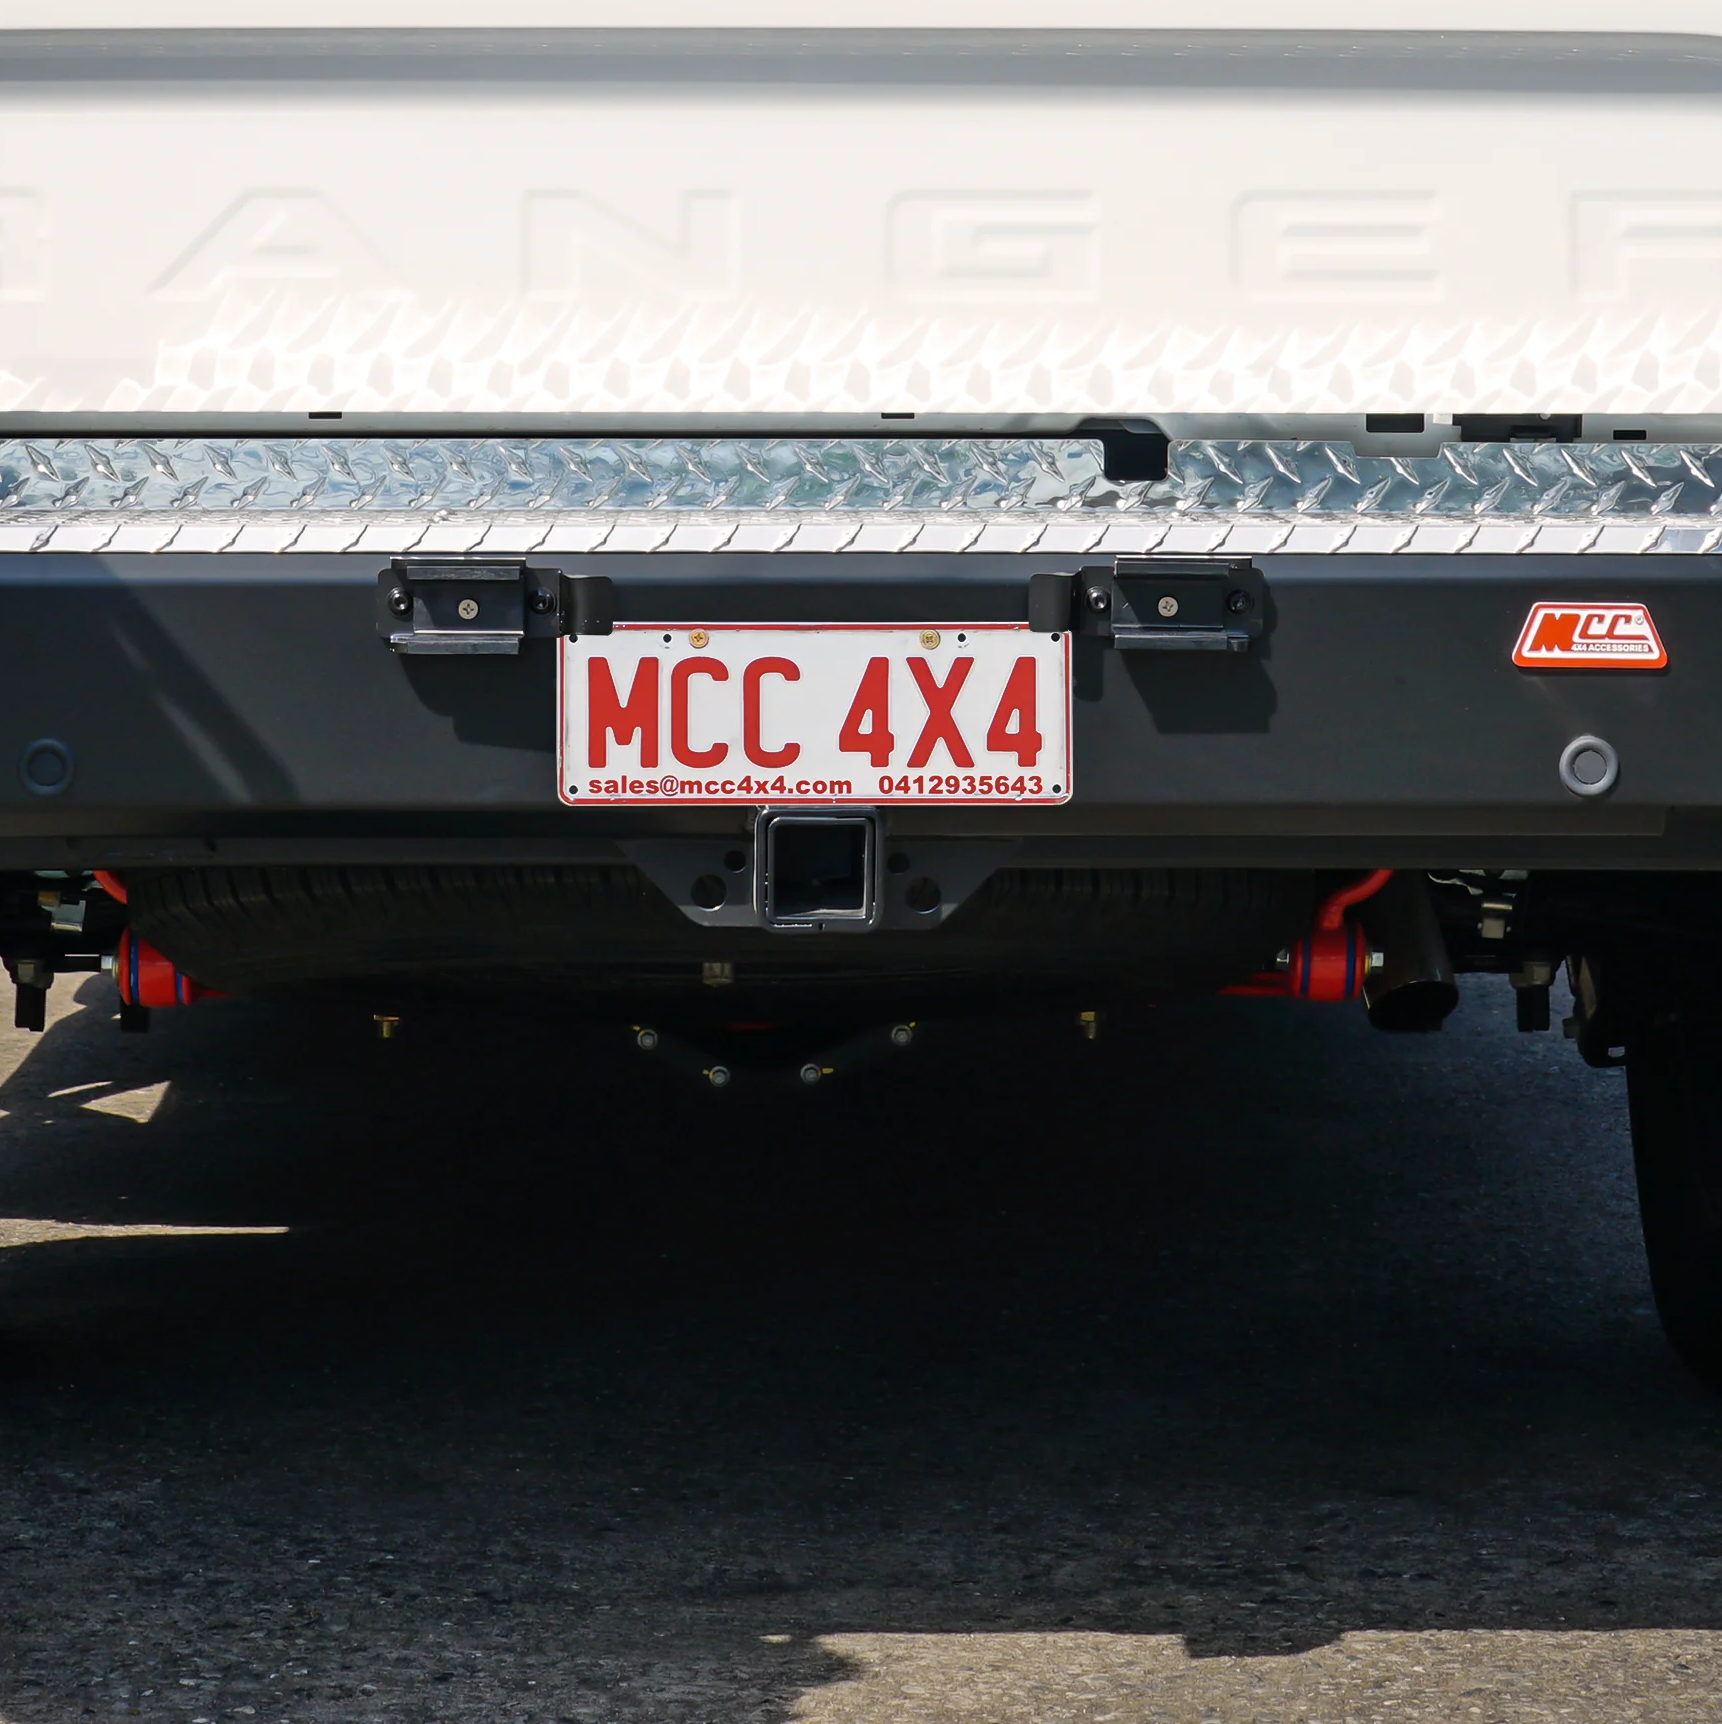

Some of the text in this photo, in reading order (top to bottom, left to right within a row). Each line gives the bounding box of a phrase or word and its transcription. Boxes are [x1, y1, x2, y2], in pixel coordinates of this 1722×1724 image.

[1527, 613, 1650, 652] MCC
[1588, 643, 1649, 652] ACCESSORIES
[588, 656, 1043, 768] MCC 4X4
[588, 774, 1044, 796] sales@mcc4x4.com 0412935643
